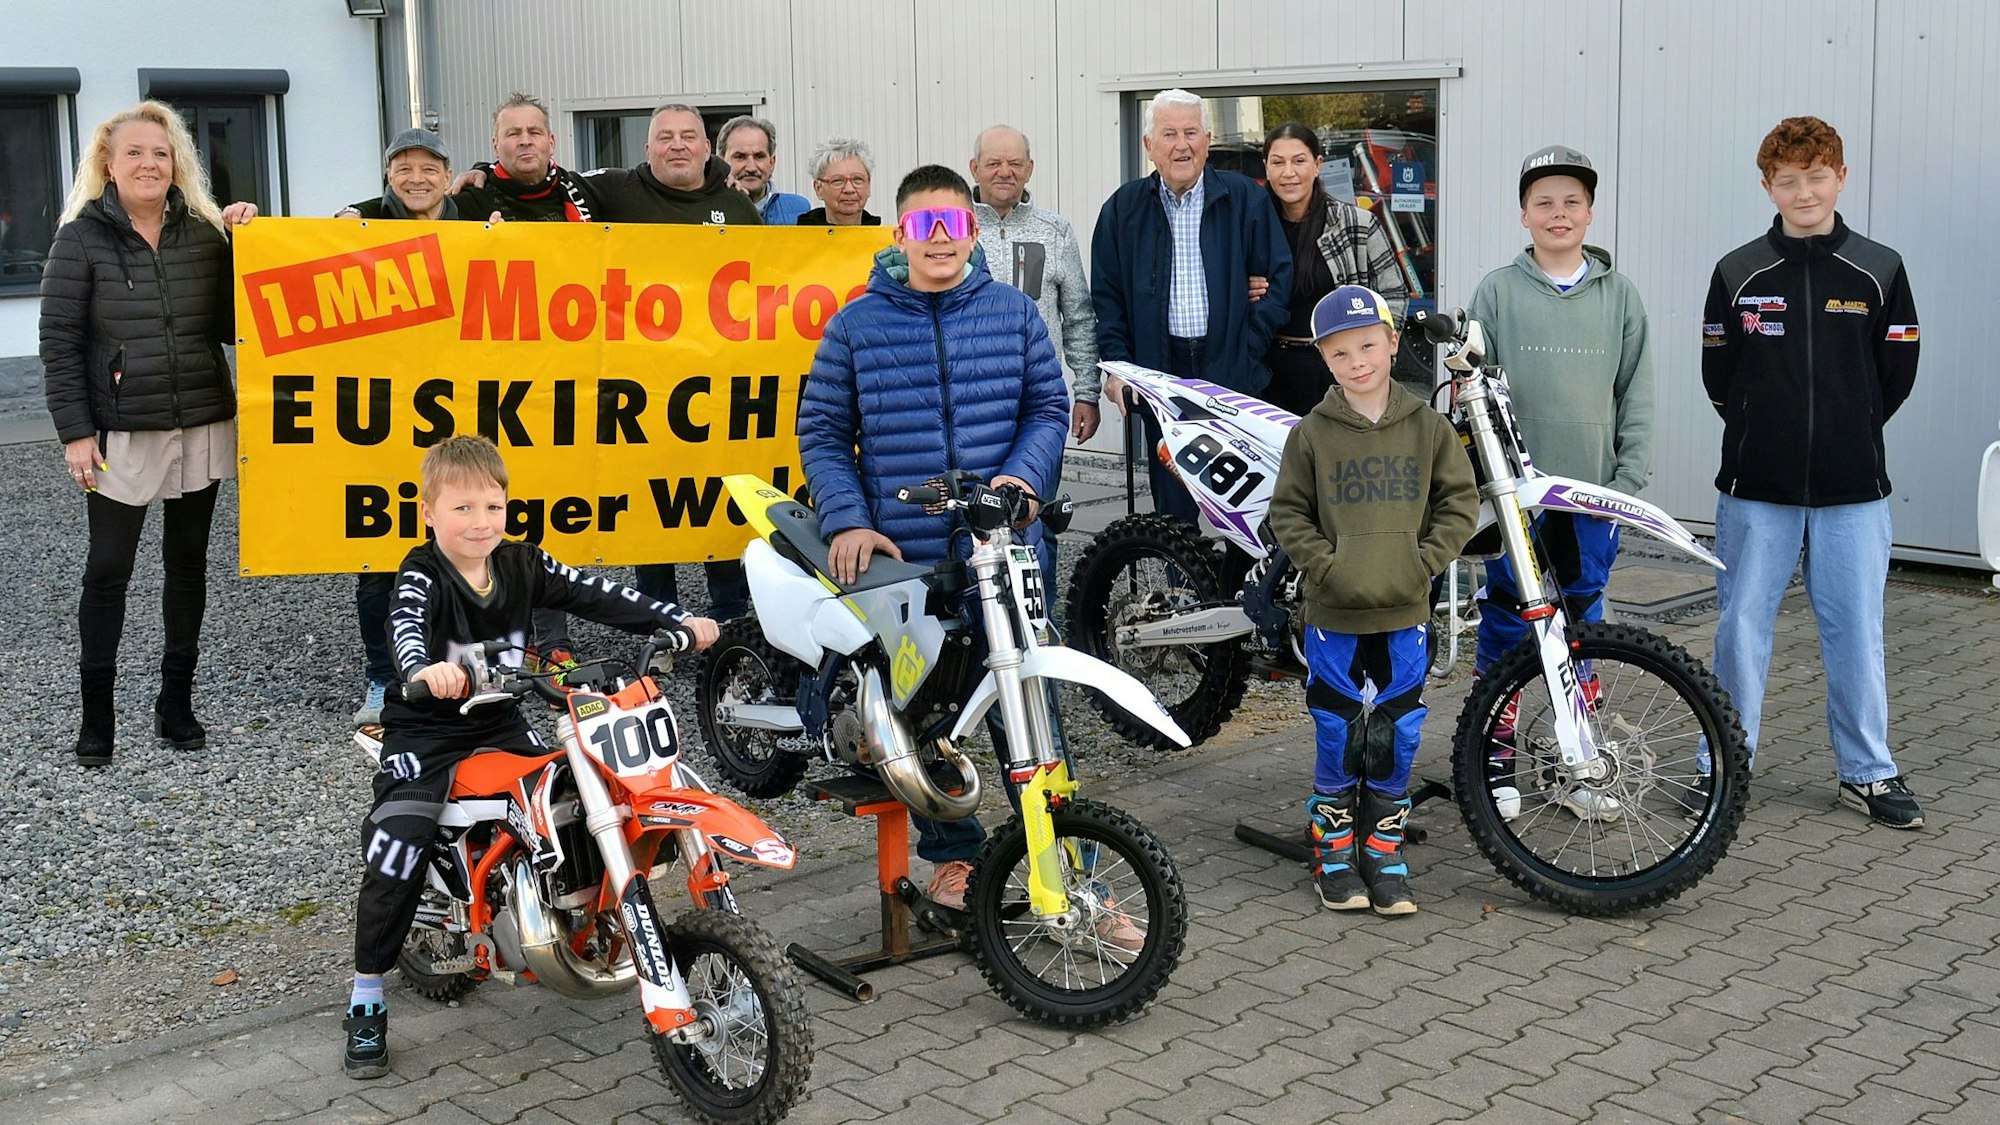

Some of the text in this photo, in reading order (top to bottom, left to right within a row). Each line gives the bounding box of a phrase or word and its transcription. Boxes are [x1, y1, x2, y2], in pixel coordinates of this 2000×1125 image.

[259, 251, 436, 338] 1.MAI
[460, 260, 682, 342] Moto
[272, 374, 809, 448] EUSKIRCH
[1175, 433, 1266, 508] 881
[1327, 479, 1421, 506] JONES
[1328, 455, 1421, 483] JACK&
[345, 481, 629, 548] Biger
[1572, 491, 1646, 518] NINETYTWO
[576, 700, 605, 717] ADAC
[589, 707, 679, 774] 100
[366, 827, 424, 881] FLY
[623, 904, 637, 930] SHOEI
[635, 902, 675, 992] DUNLOP
